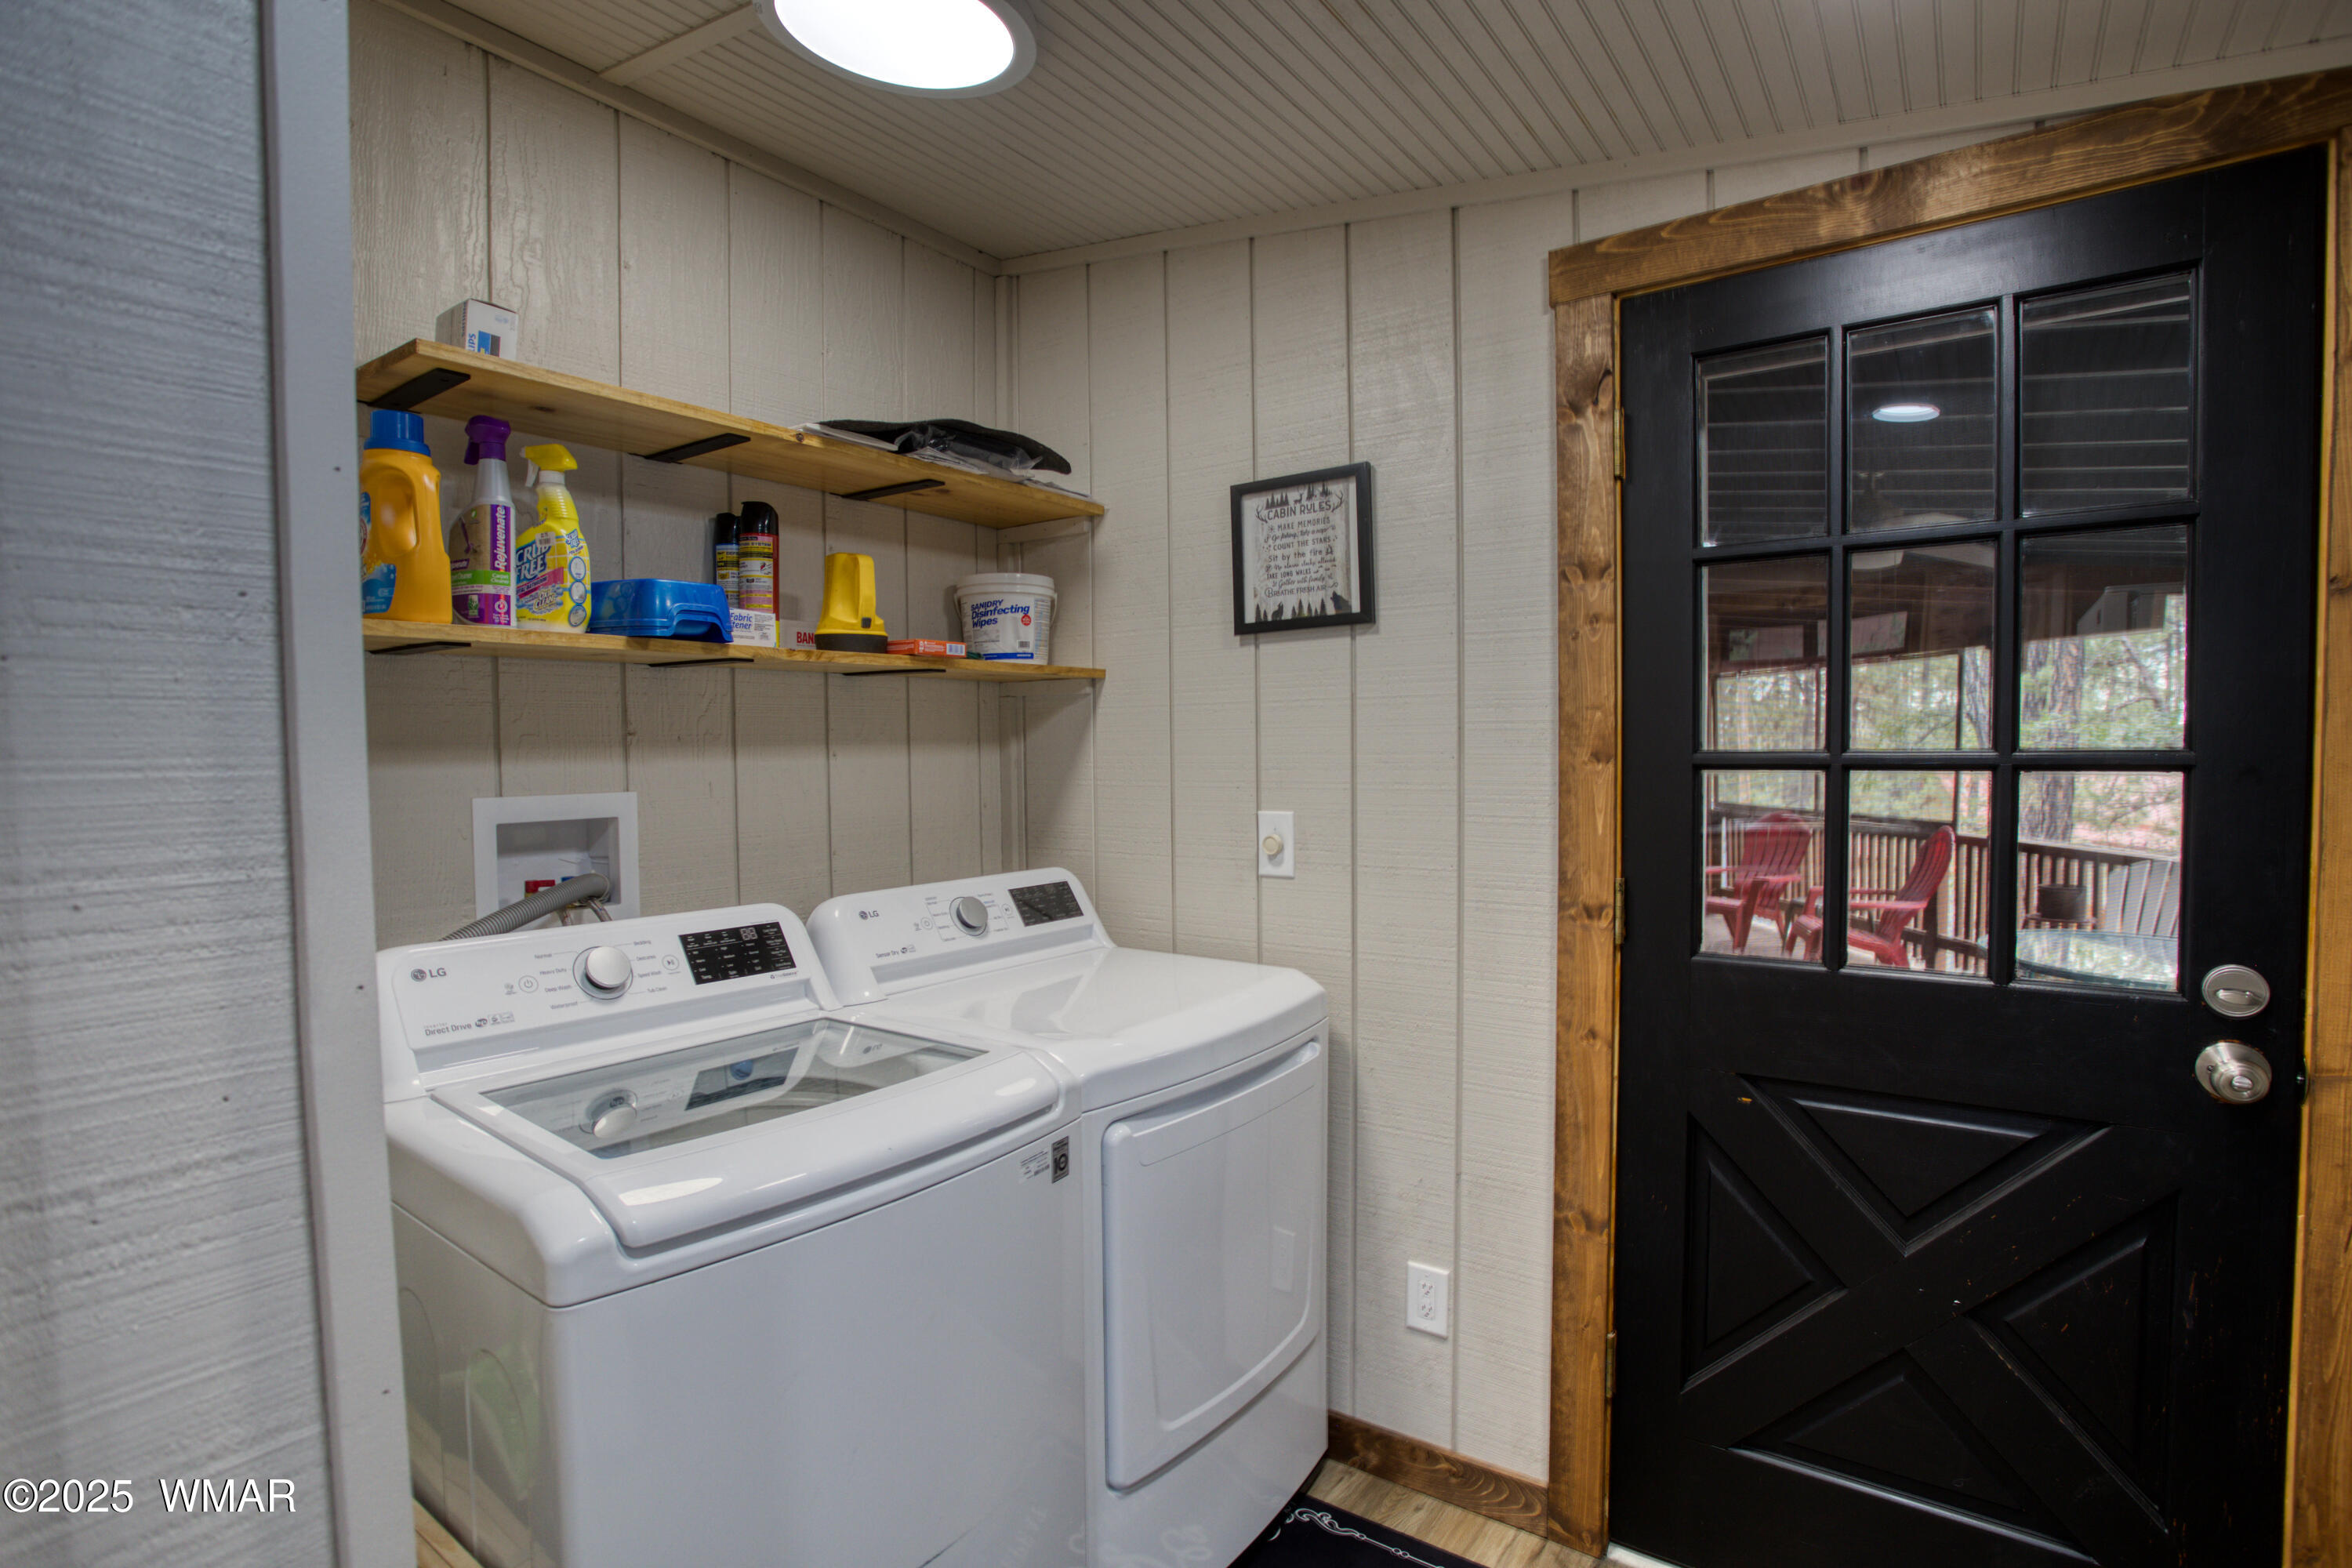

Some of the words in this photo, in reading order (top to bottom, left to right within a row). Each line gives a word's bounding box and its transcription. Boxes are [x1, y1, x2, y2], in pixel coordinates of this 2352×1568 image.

[1268, 506, 1296, 520] CABIN
[1300, 501, 1331, 514] RULES
[1278, 522, 1294, 531] MAKE
[1298, 517, 1330, 528] MEMORIES
[494, 506, 507, 570] Rejuvenate
[1273, 542, 1294, 551] COUNT
[1312, 535, 1331, 546] STARS
[516, 543, 550, 566] CRUB
[1282, 554, 1290, 566] by
[1280, 570, 1294, 579] LONG
[1297, 586, 1315, 594] FRESH
[971, 599, 1004, 612] SANIDRY
[971, 604, 1029, 619] Disinfecting
[730, 613, 753, 622] Fabric
[730, 619, 752, 629] tener
[972, 617, 997, 629] Wipes
[797, 631, 816, 644] BAN
[428, 967, 447, 978] LG
[550, 1001, 578, 1010] Waterproof
[425, 1026, 450, 1036] Direct
[451, 1023, 472, 1032] Drive
